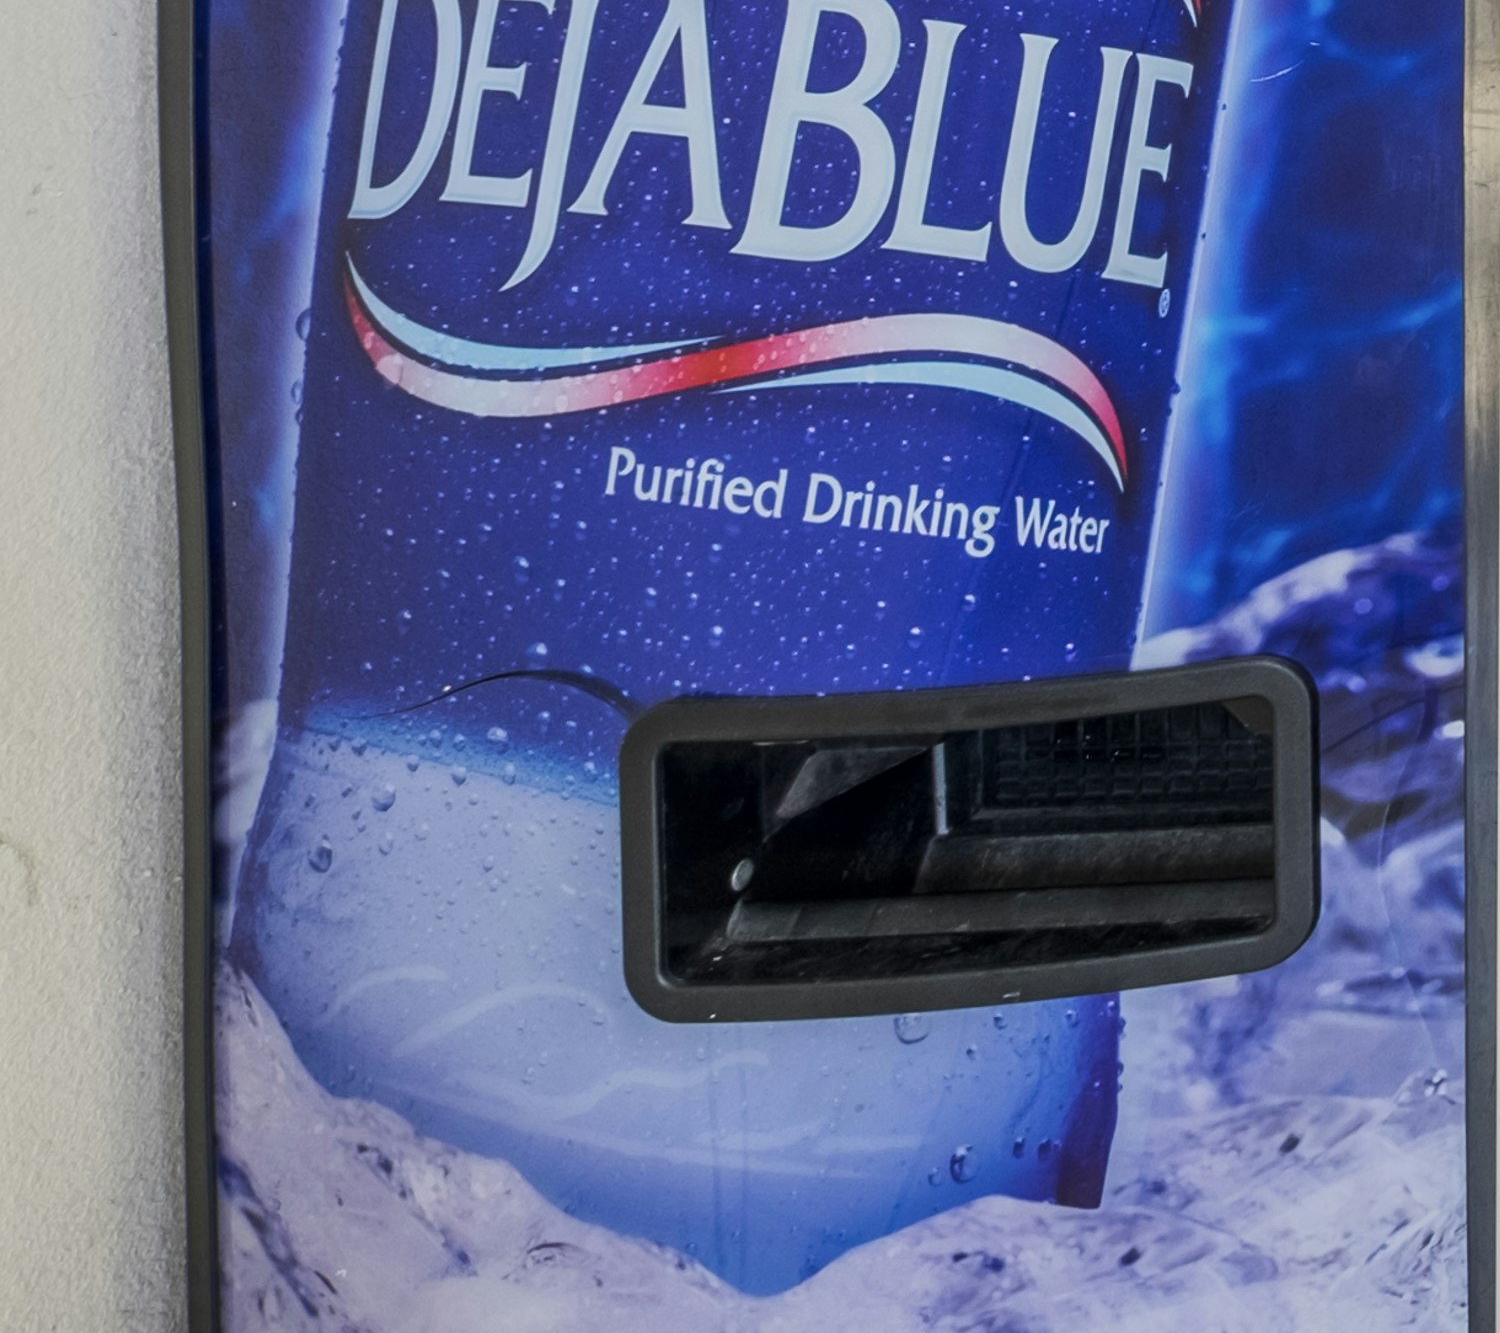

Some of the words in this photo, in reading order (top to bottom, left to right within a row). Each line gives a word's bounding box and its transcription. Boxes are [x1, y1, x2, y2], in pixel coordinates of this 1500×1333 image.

[604, 447, 790, 519] Purified
[802, 471, 1000, 559] Drinking
[1013, 495, 1109, 555] Water
